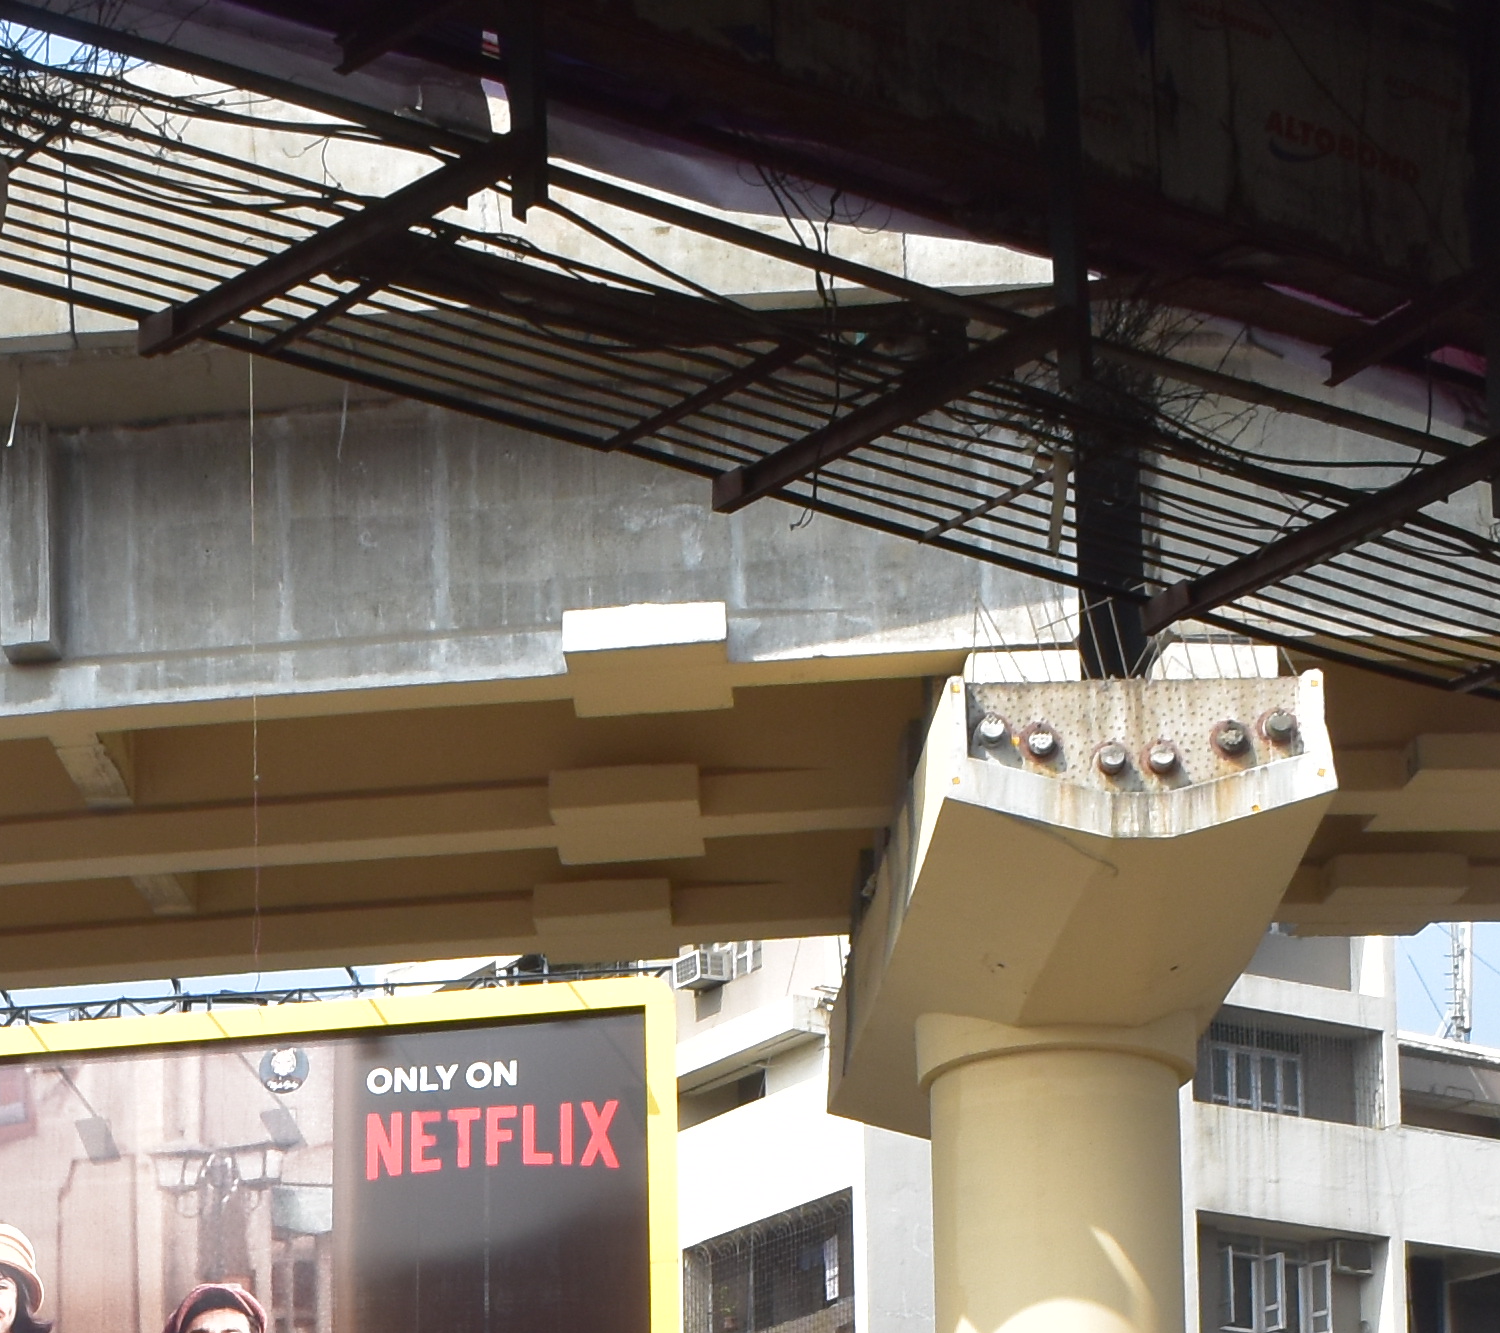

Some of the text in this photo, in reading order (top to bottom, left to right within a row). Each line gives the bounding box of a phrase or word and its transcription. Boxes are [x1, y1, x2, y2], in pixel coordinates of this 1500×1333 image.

[1264, 110, 1421, 184] ALTOBOND
[366, 1060, 517, 1095] ONLY ON
[365, 1100, 620, 1181] NETFLIX
